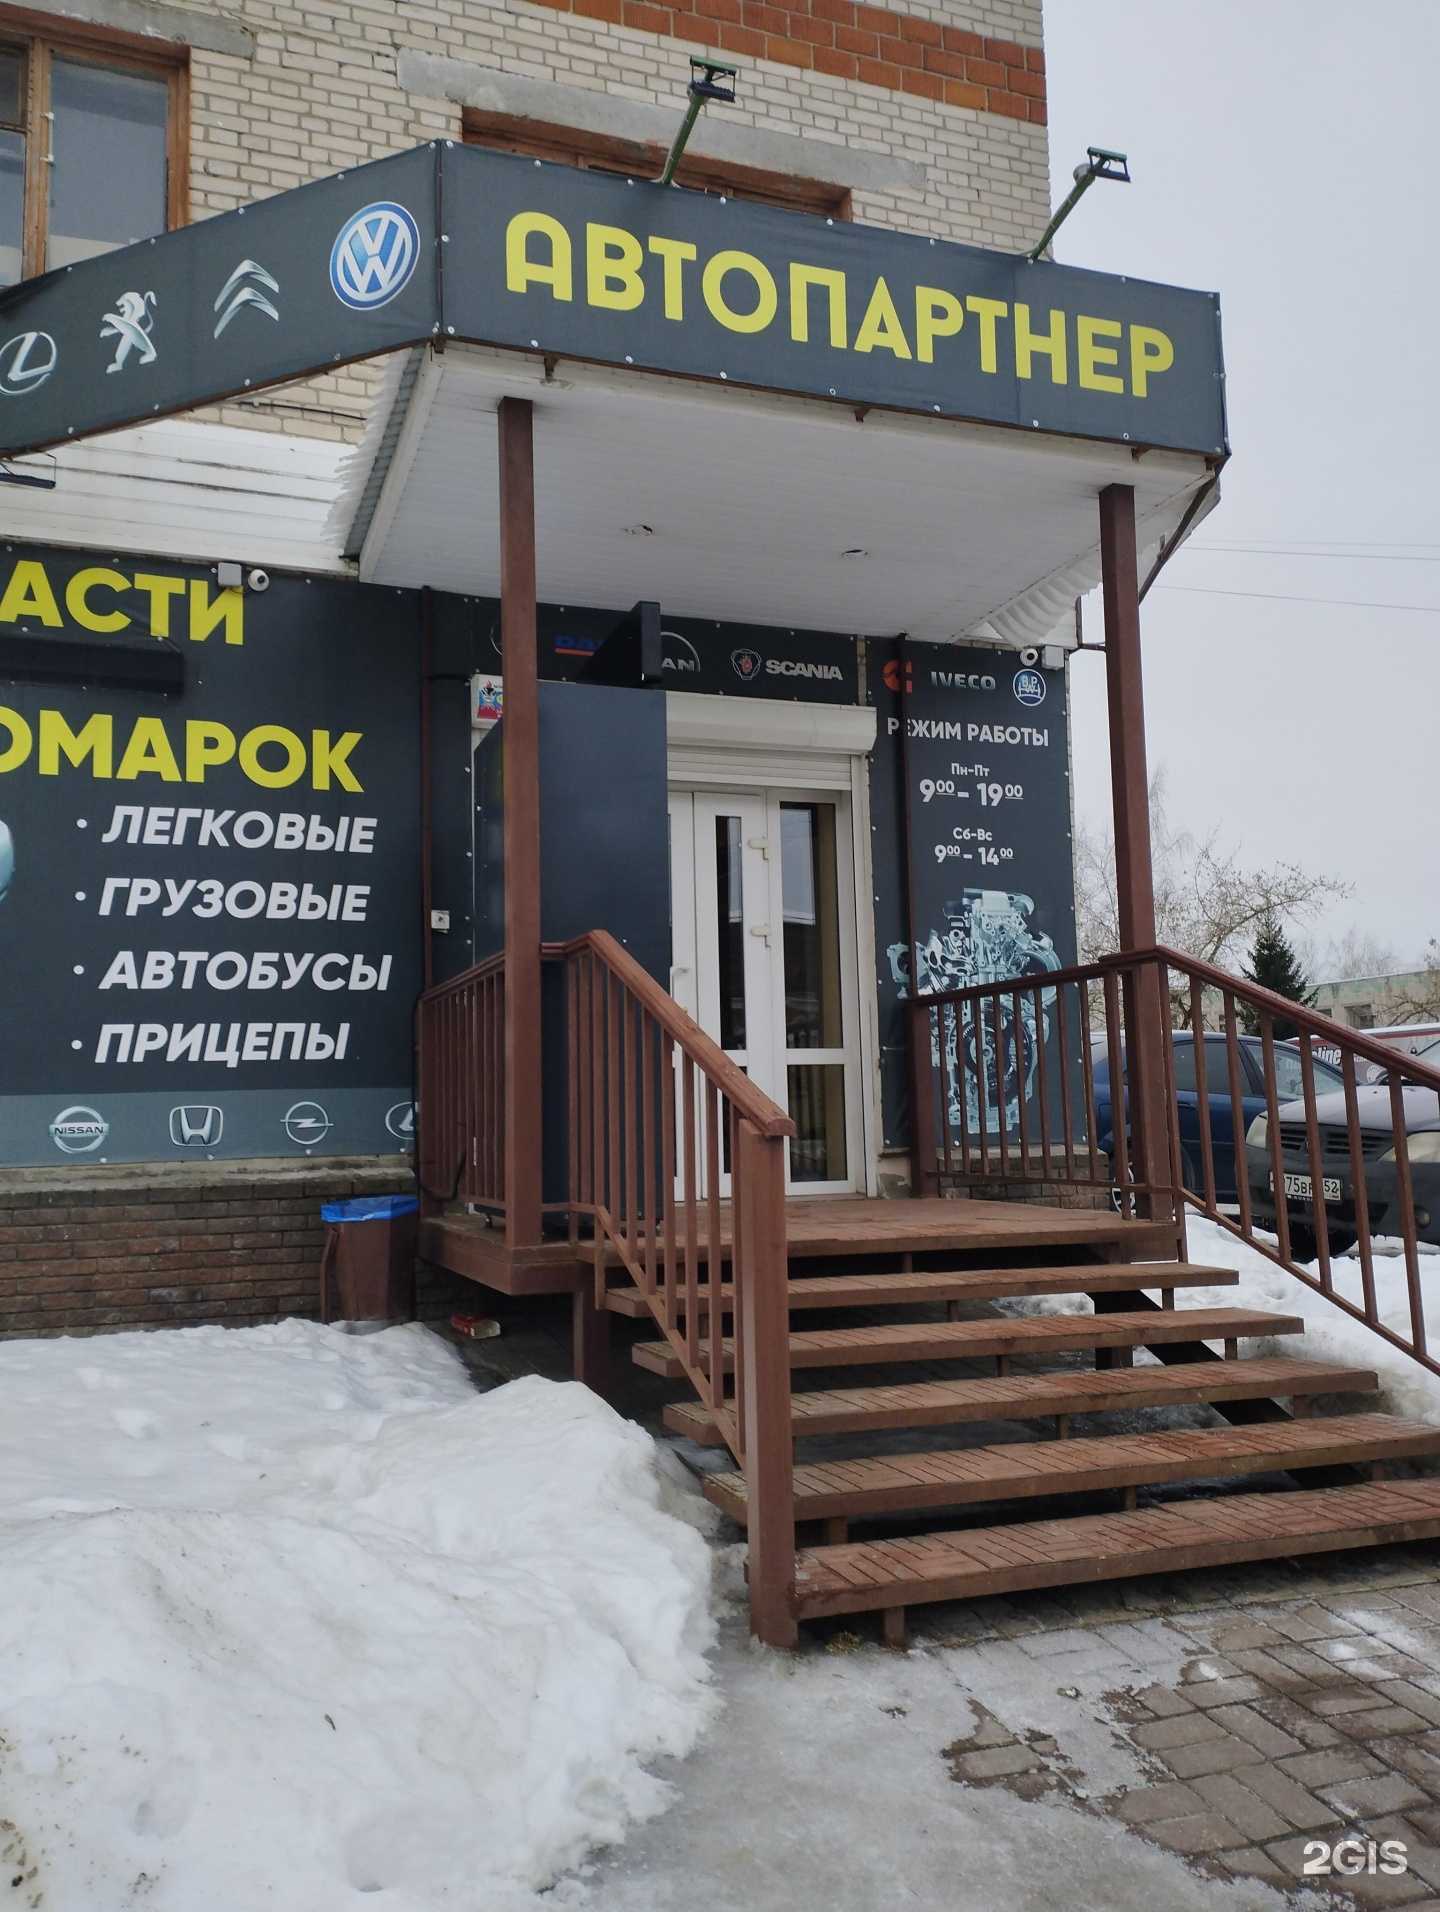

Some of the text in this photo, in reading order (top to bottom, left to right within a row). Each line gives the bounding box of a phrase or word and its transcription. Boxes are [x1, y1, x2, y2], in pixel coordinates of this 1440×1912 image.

[506, 211, 1174, 397] АВТОПАРТНЕР
[661, 657, 695, 672] AN
[765, 659, 843, 680] SCANIA
[930, 671, 996, 690] IVECO
[887, 717, 1049, 747] РЖИМ РАБОТЫ
[951, 763, 990, 777] Пн-Пт
[102, 805, 377, 853] ЛЕГКОВЫЕ
[952, 827, 993, 842] Сб-Вс
[98, 877, 370, 921] ГРУЗОВЫЕ
[98, 951, 392, 991] АВТОБУСЫ
[95, 1023, 350, 1068] ПРИЦЕПЫ
[54, 1126, 104, 1135] NISSAN
